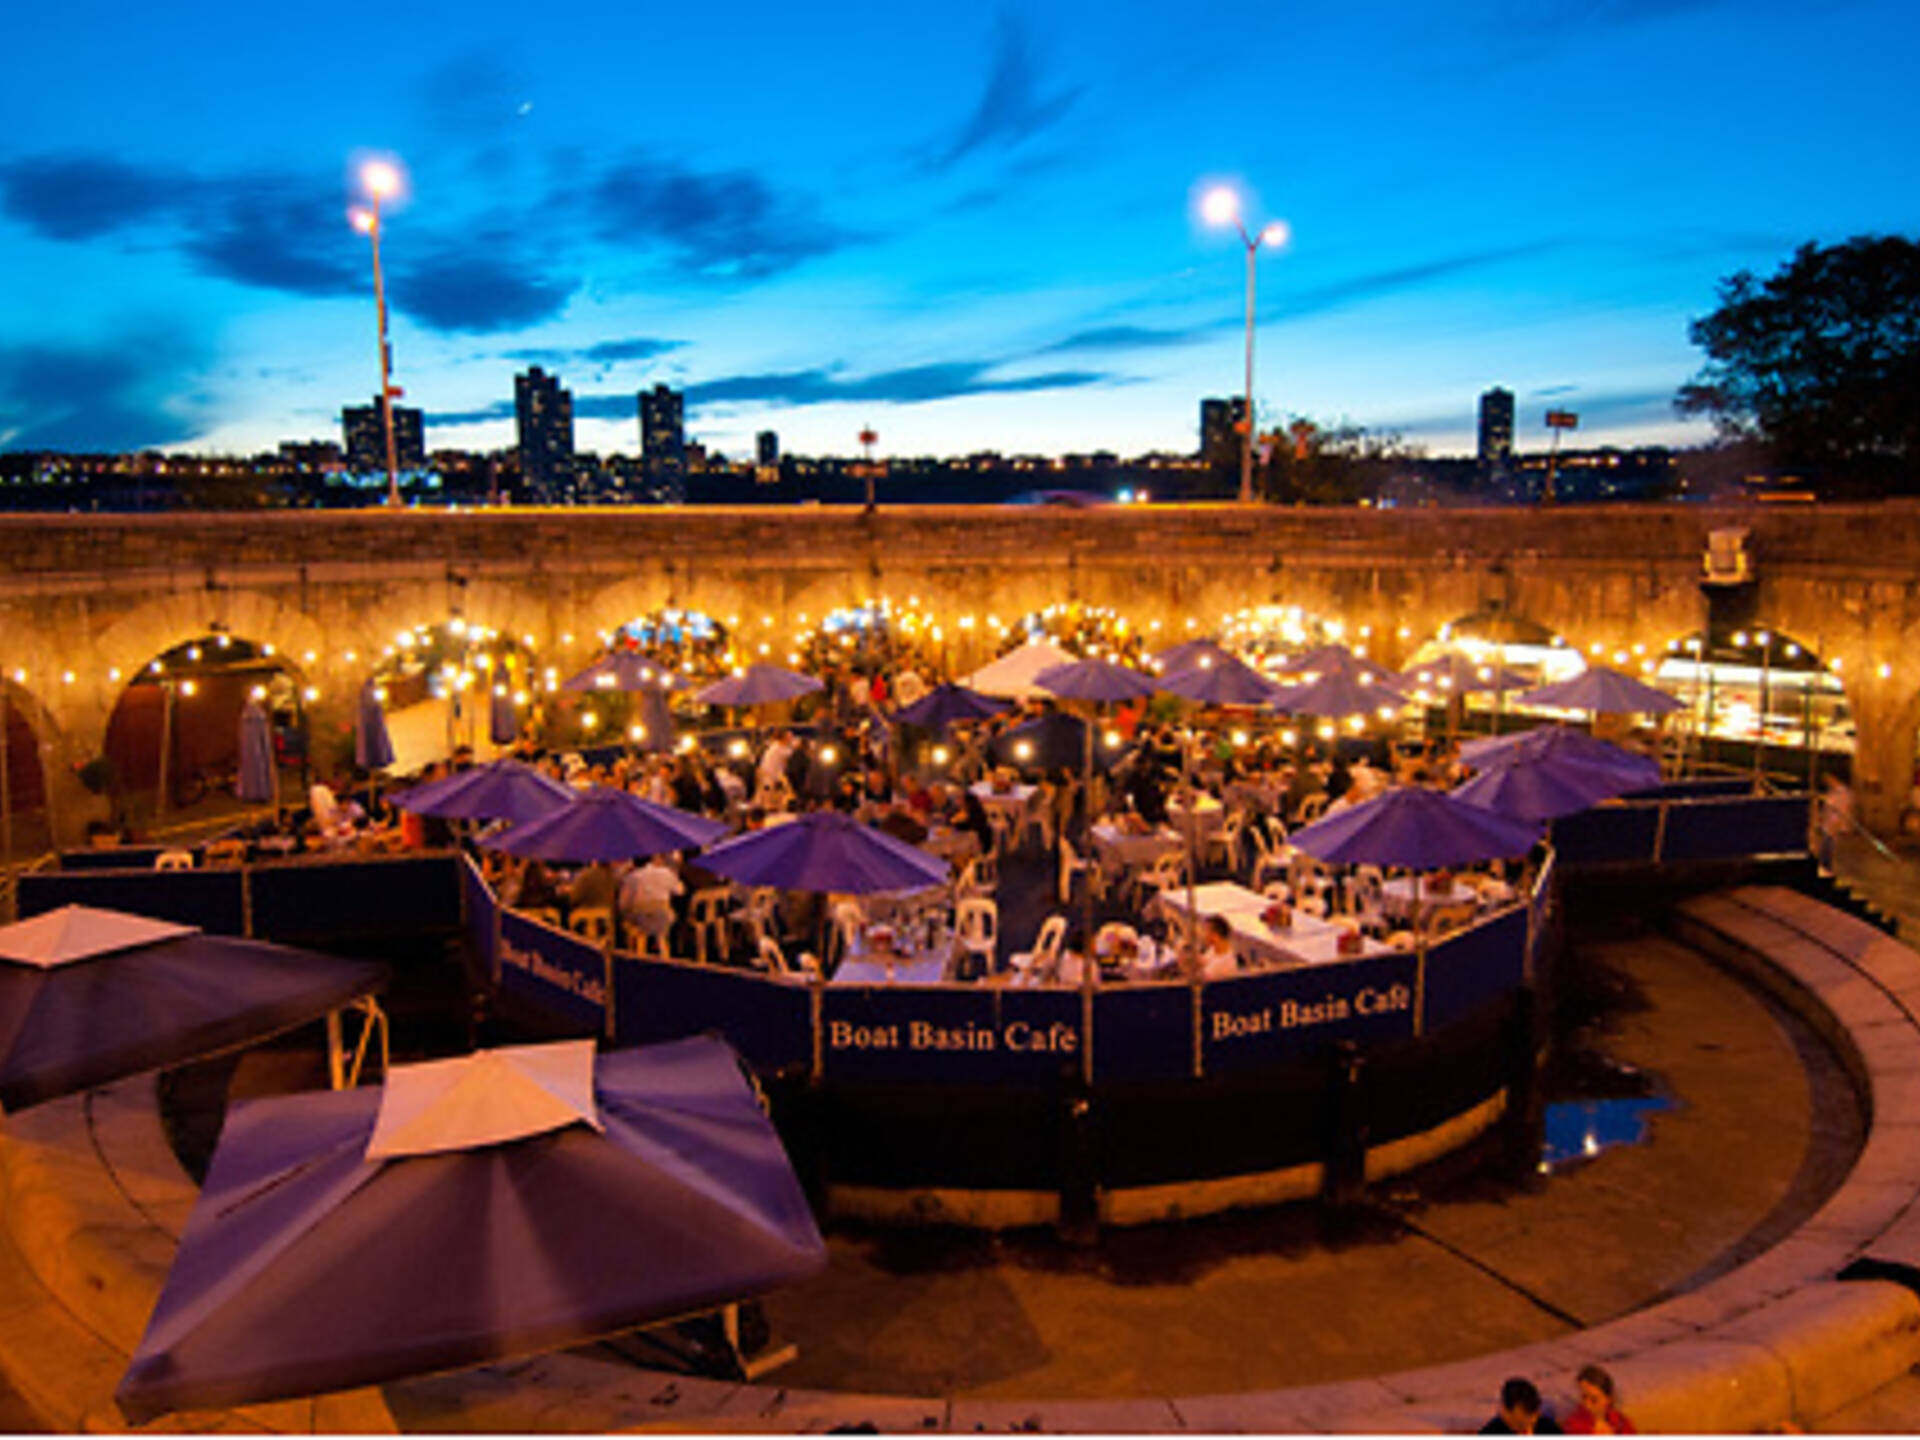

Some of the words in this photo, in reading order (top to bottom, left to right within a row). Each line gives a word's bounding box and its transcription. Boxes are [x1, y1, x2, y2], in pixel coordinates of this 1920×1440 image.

[830, 1020, 899, 1047] Boat
[909, 1020, 995, 1050] Basin
[1212, 1010, 1271, 1040] Boat
[1280, 993, 1349, 1028] Basin
